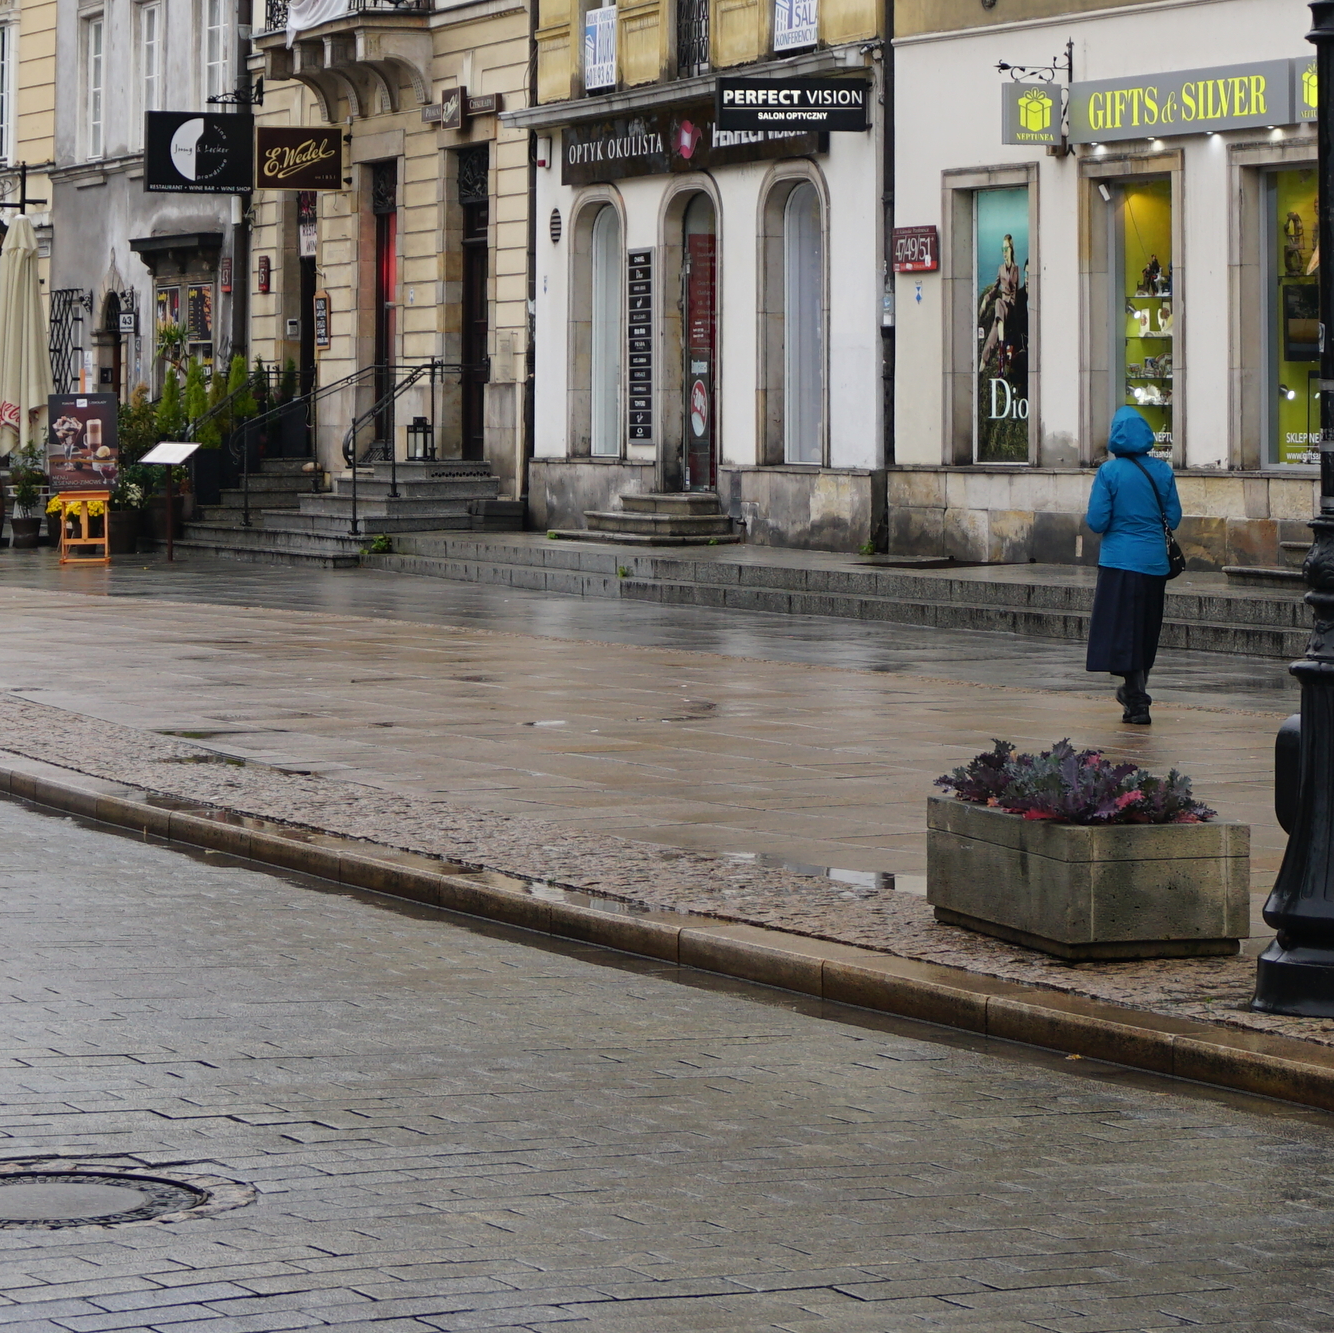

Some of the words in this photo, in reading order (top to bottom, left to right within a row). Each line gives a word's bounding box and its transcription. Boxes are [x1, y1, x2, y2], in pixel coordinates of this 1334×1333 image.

[723, 90, 802, 104] PERFECT
[806, 89, 863, 104] VISION
[1088, 86, 1159, 131] GIFTS
[1161, 91, 1177, 123] &
[1181, 74, 1267, 122] SILVER
[758, 111, 785, 120] SALON
[786, 111, 828, 120] OPTYCZNY
[1016, 132, 1054, 142] NEPTUNEA
[569, 140, 604, 165] OPTYK
[608, 132, 663, 160] OKULISTA
[122, 316, 132, 325] 43
[1286, 432, 1309, 444] SKLEP
